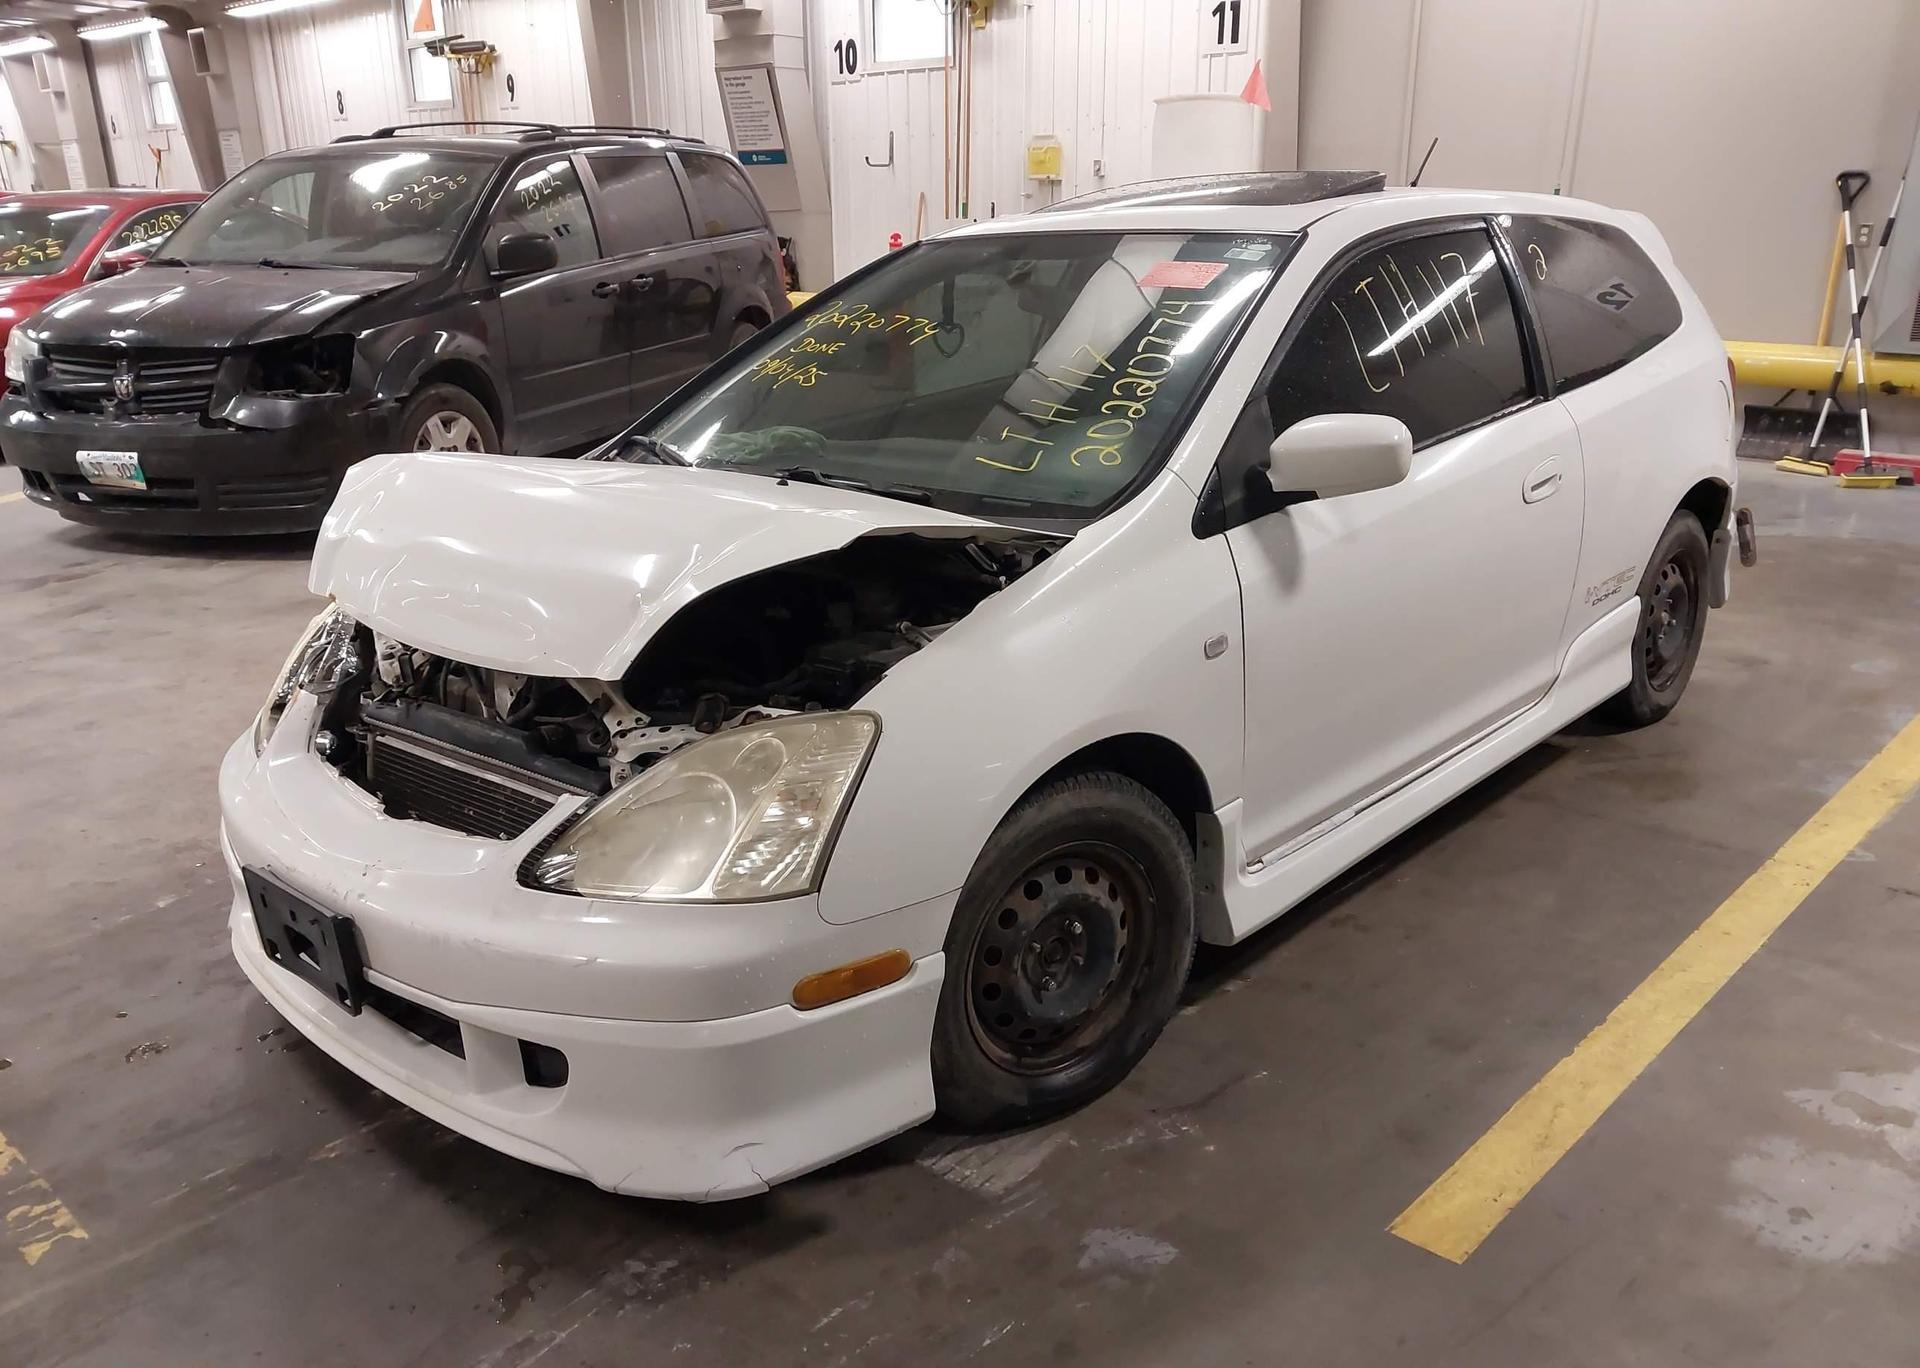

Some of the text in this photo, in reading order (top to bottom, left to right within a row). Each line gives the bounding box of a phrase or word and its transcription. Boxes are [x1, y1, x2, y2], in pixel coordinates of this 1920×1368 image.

[1212, 0, 1241, 45] 11
[833, 38, 858, 75] 10
[506, 73, 516, 102] 9
[336, 90, 345, 115] 8
[372, 174, 449, 212] 2022
[520, 174, 562, 210] 2022
[0, 238, 64, 258] 022
[0, 246, 61, 272] 2695
[790, 337, 846, 354] DONE
[1592, 585, 1622, 607] DOHC
